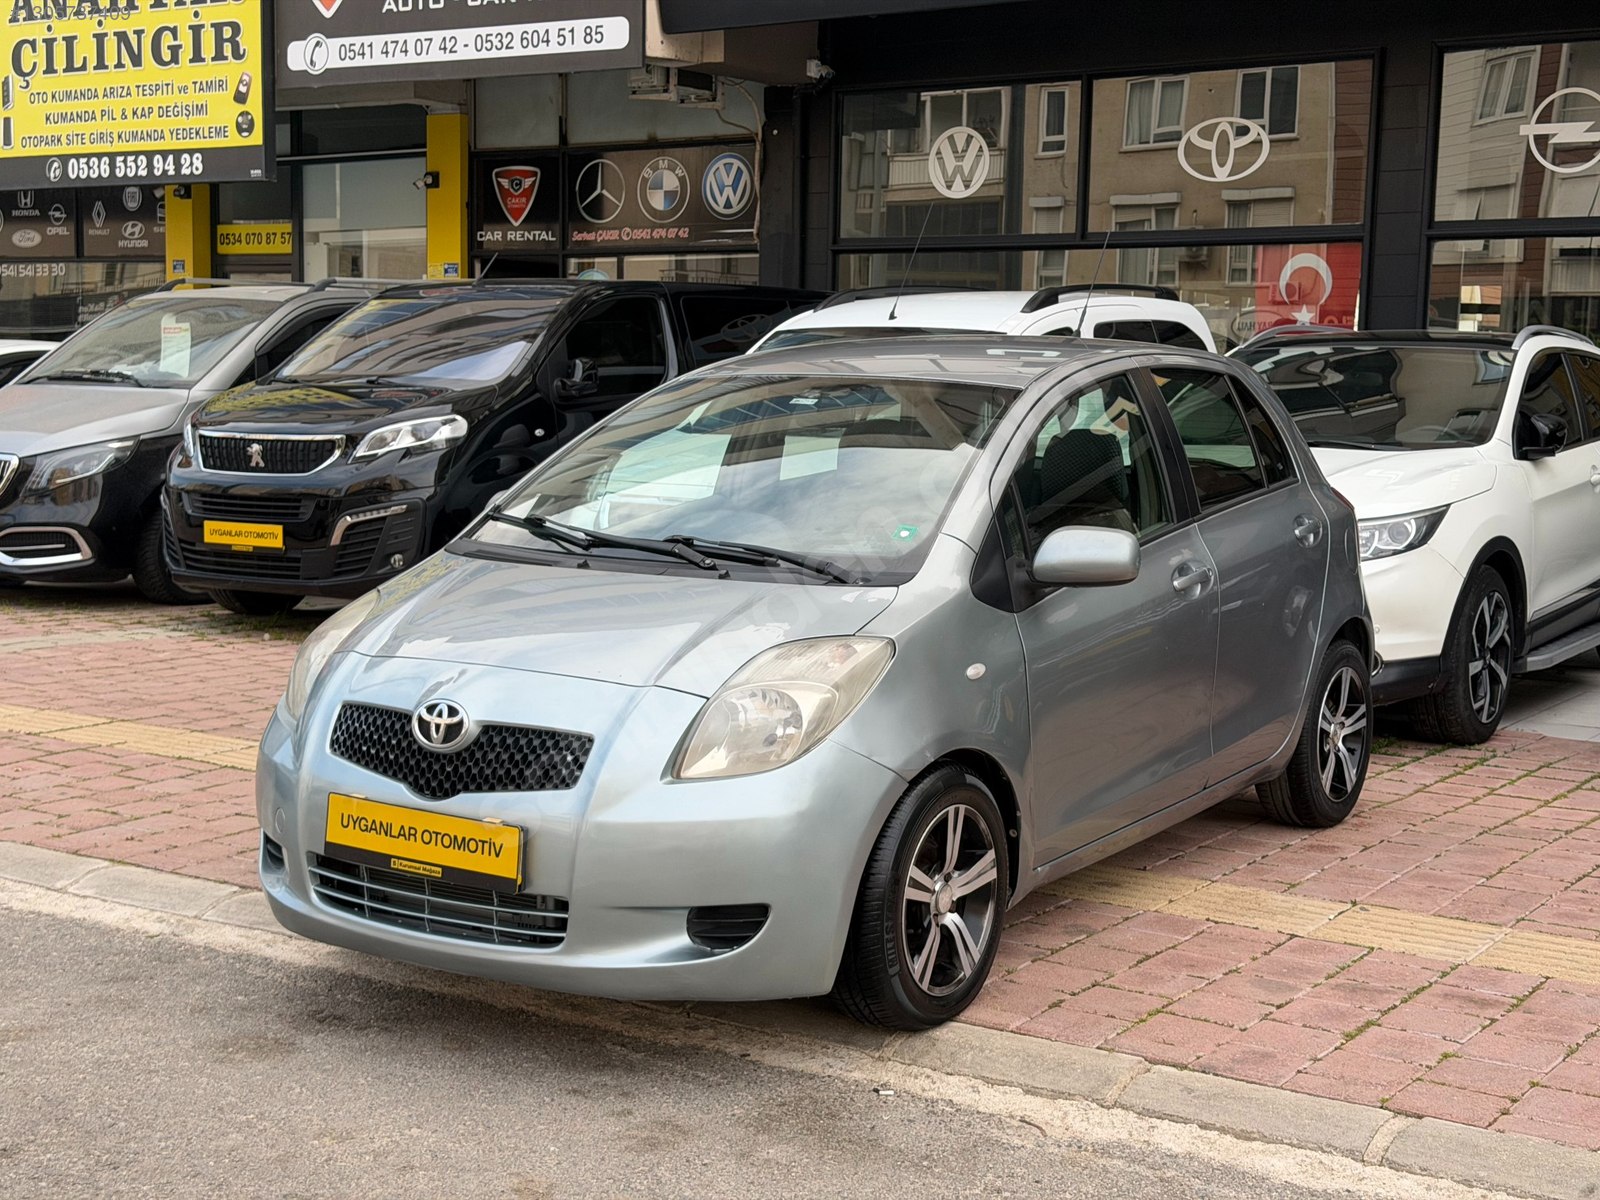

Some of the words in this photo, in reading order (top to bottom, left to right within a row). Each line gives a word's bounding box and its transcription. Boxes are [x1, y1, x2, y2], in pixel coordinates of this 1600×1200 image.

[11, 10, 246, 90] ÇİLİNGİR
[338, 42, 374, 62] 0541
[380, 40, 409, 59] 474
[414, 38, 434, 57] 07
[438, 36, 458, 55] 42
[474, 32, 515, 52] 0532
[520, 29, 551, 49] 604
[557, 27, 575, 46] 51
[583, 25, 605, 44] 85
[29, 91, 48, 105] OTO
[51, 87, 99, 104] KUMANDA
[102, 85, 132, 101] ARIZA
[135, 79, 174, 98] TESPİTİ
[177, 85, 189, 95] ve
[192, 75, 229, 94] TAMİRİ
[45, 110, 97, 126] KUMANDA
[100, 106, 118, 123] PİL
[121, 107, 128, 121] &
[132, 104, 154, 120] KAP
[158, 99, 209, 121] DEĞİŞİMİ
[21, 134, 63, 149] OTOPARK
[66, 129, 86, 147] SİTE
[89, 127, 114, 147] GİRİŞ
[117, 128, 166, 144] KUMANDA
[169, 125, 229, 141] YEDEKLEME
[67, 157, 111, 180] 0536
[115, 155, 148, 178] 552
[152, 154, 175, 176] 94
[181, 152, 204, 176] 28
[12, 209, 40, 217] HONDA
[46, 226, 70, 236] OPEL
[89, 228, 110, 236] RENAULT
[219, 233, 243, 246] 0534
[245, 232, 263, 245] 070
[266, 231, 277, 245] 87
[280, 231, 292, 245] 57
[477, 231, 503, 241] CAR
[507, 230, 557, 241] RENTAL
[118, 239, 149, 248] HYUNDAI
[0, 263, 18, 278] 541
[19, 263, 35, 277] 541
[36, 263, 49, 277] 33
[51, 262, 66, 277] 30
[209, 528, 243, 537] UYGANLAR
[244, 530, 279, 540] OTOMOTİV
[340, 812, 418, 843] UYGANLAR
[420, 828, 504, 859] OTOMOTİV
[400, 862, 421, 871] Kurumsal
[422, 866, 441, 875] Mağaza
